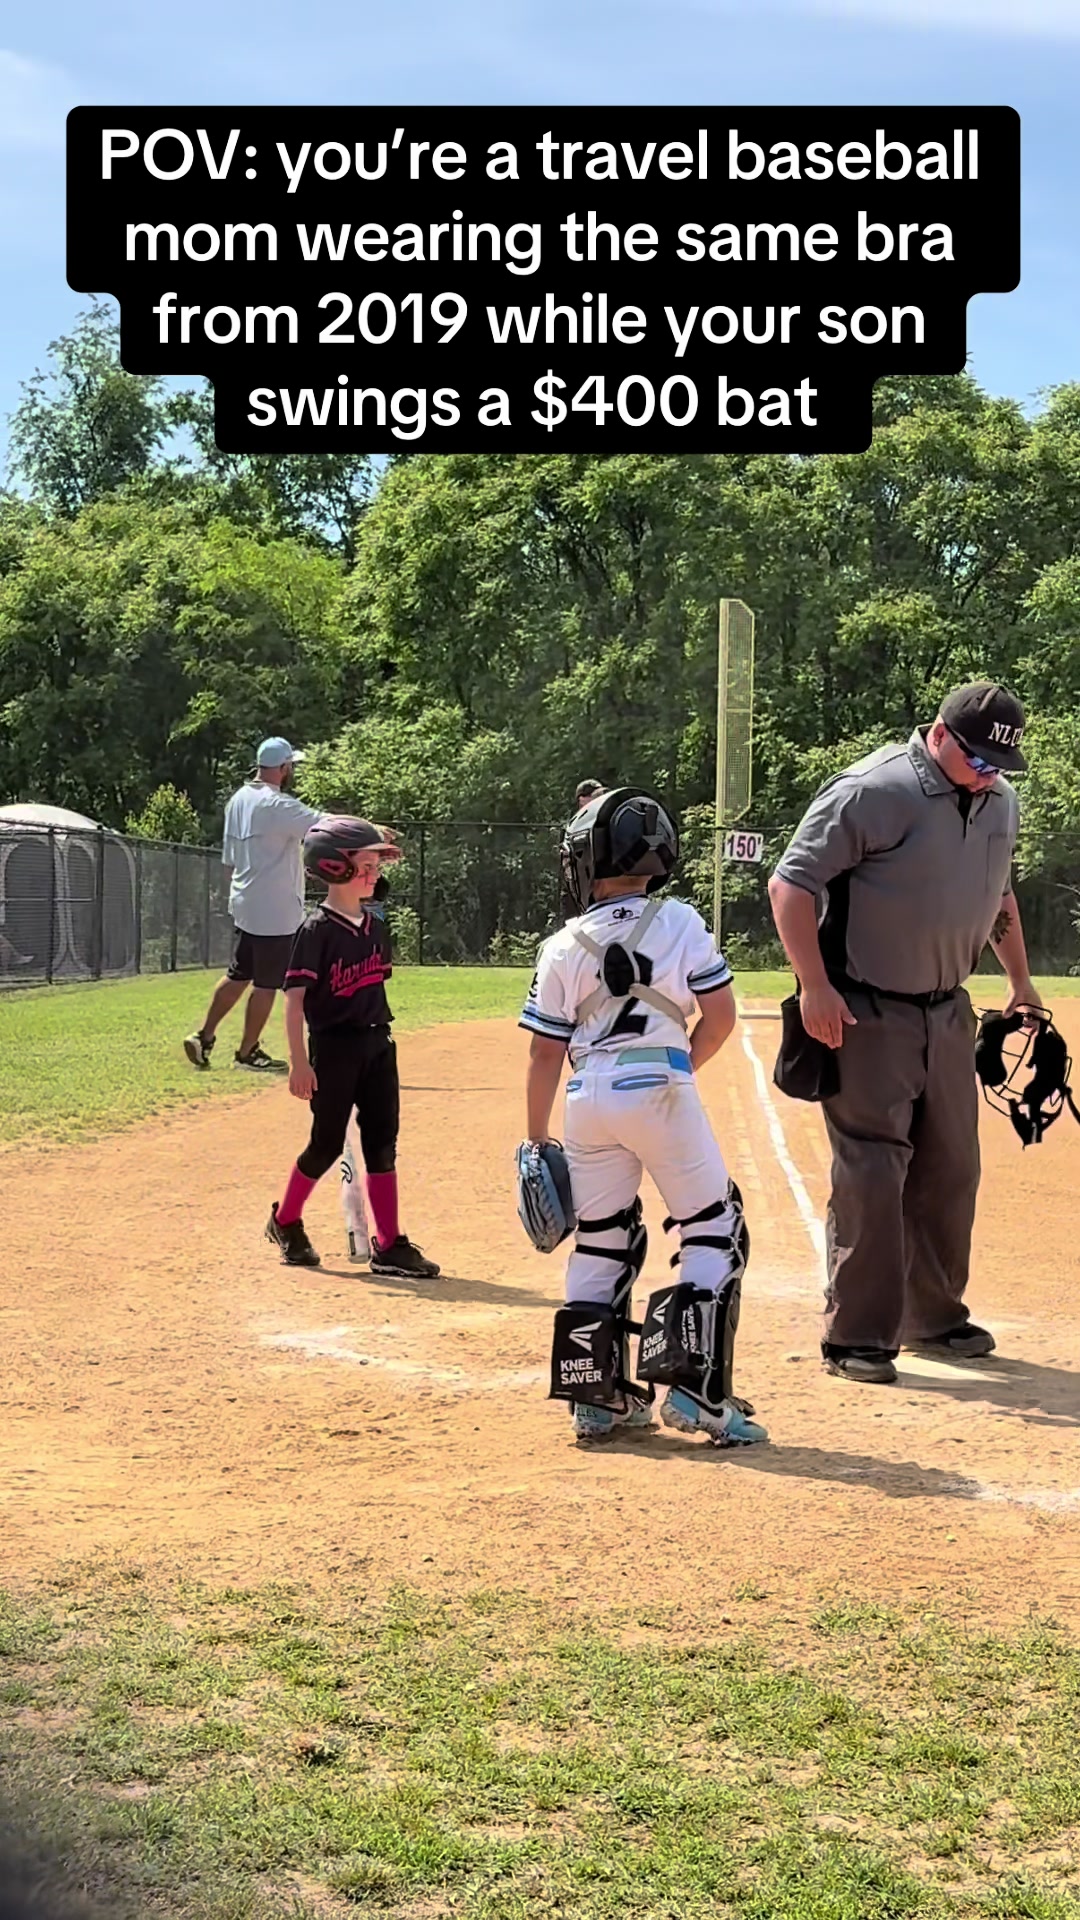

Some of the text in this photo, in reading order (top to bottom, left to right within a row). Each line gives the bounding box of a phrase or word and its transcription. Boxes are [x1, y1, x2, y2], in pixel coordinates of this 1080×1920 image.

[727, 834, 761, 858] 150'
[592, 951, 654, 1046] 2
[642, 1338, 668, 1362] SAVER
[643, 1329, 664, 1350] KNEE
[560, 1358, 594, 1372] KNEE
[560, 1370, 602, 1384] SAVER
